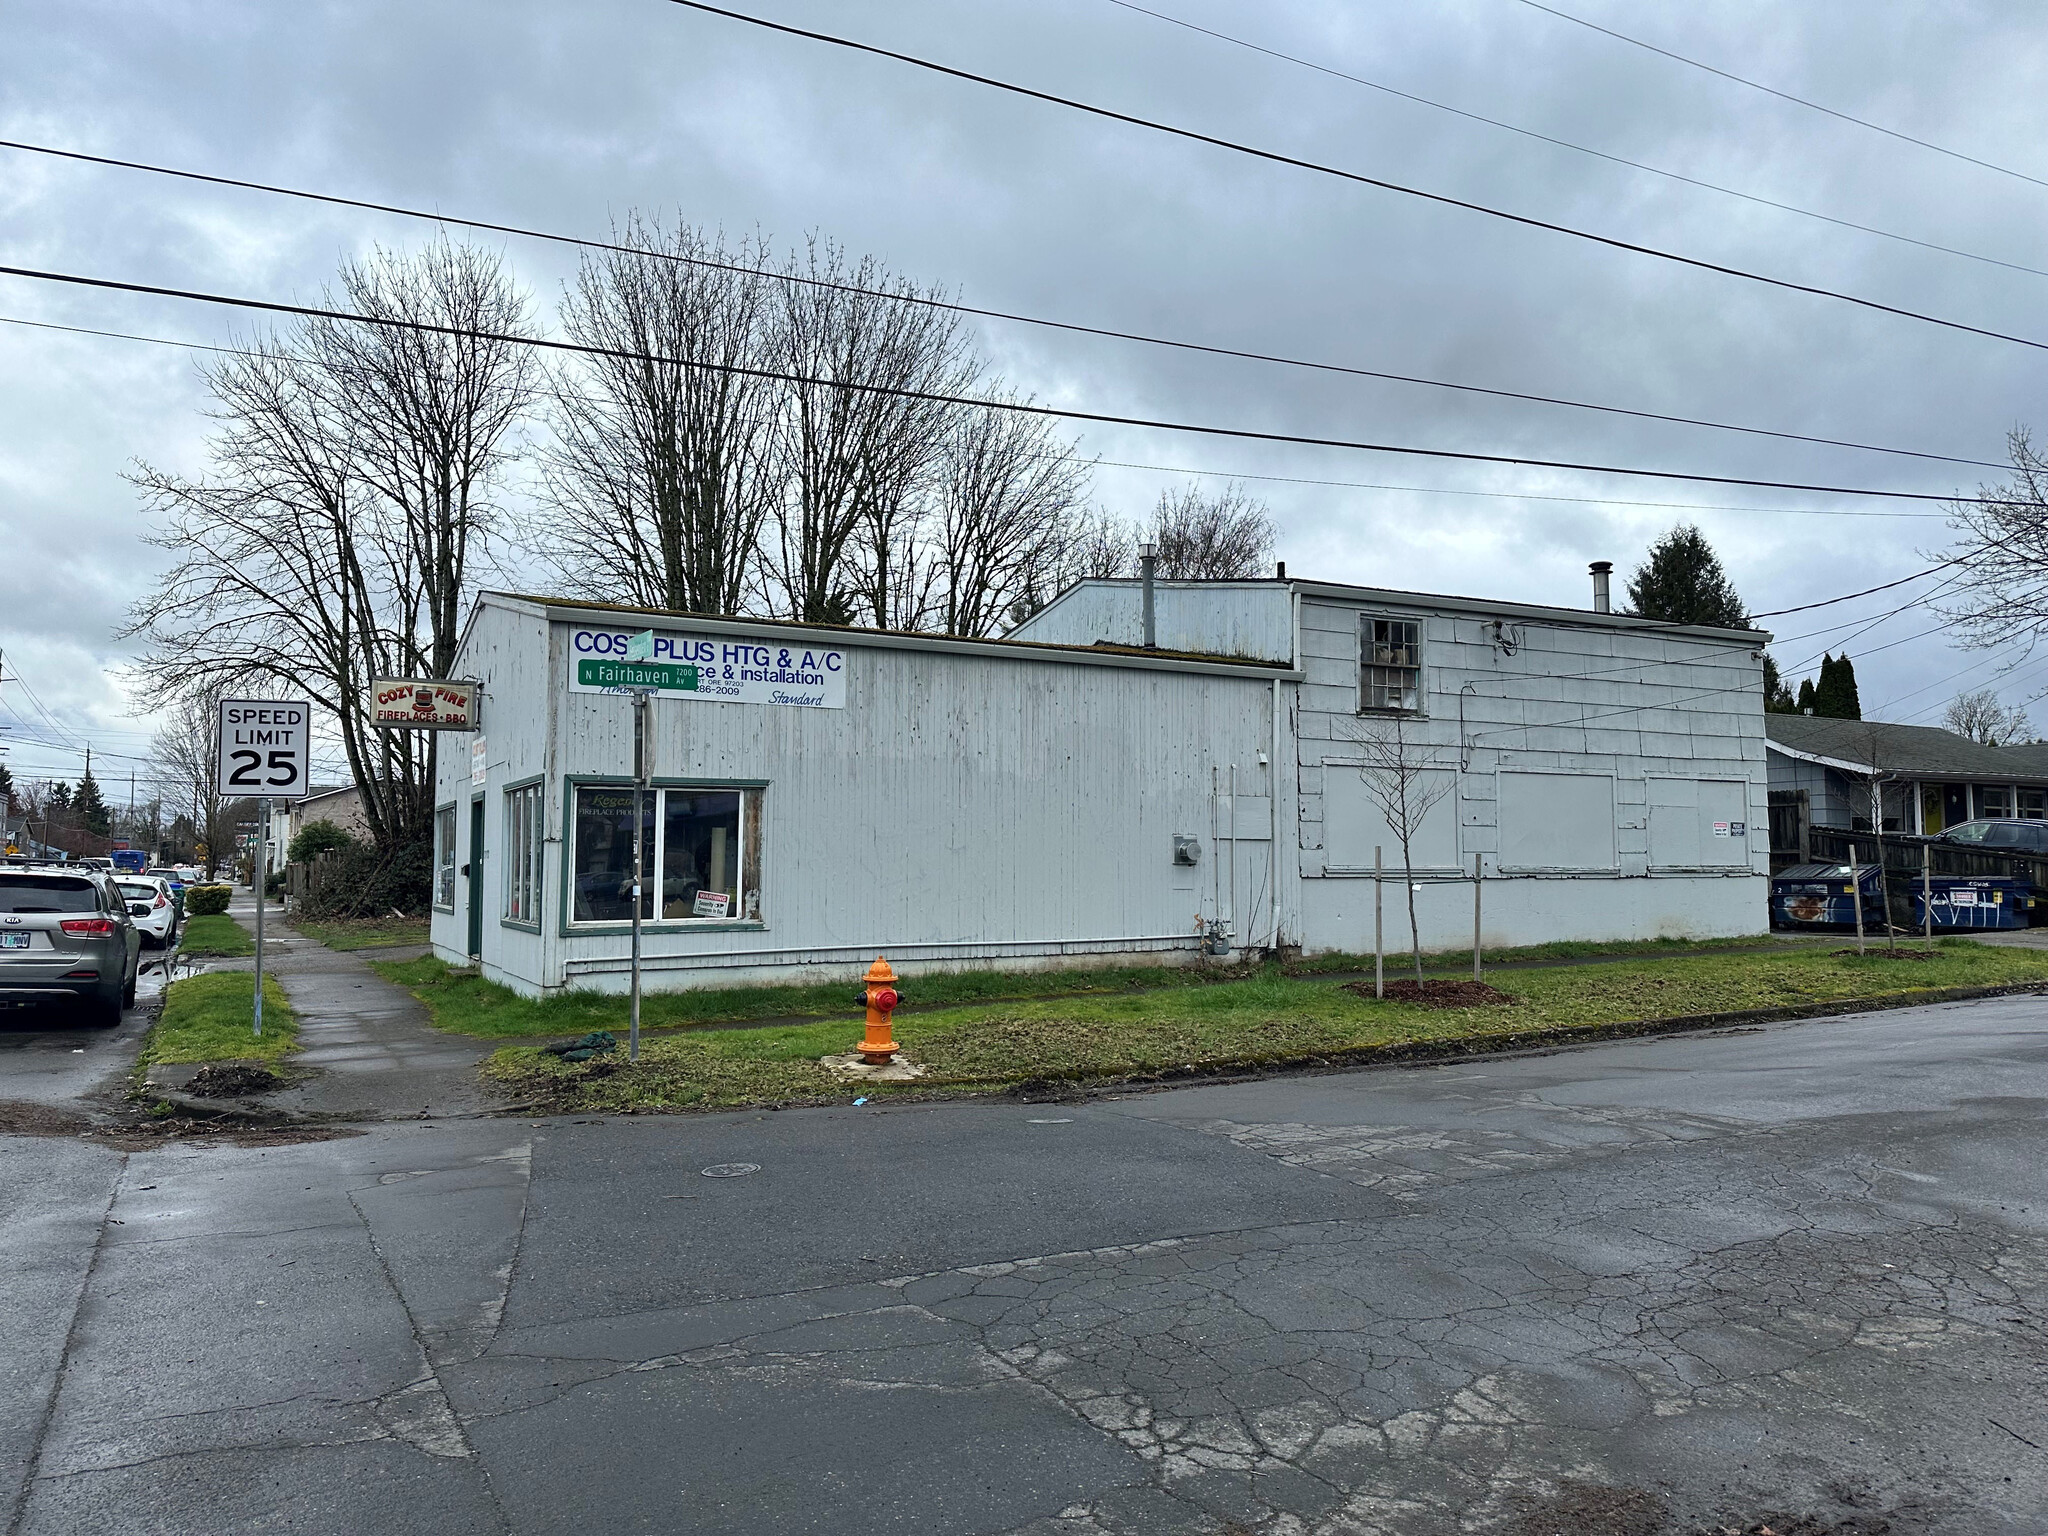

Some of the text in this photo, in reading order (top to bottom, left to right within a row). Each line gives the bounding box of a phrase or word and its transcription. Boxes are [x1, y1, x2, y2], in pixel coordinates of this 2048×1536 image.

[574, 631, 635, 656] COS
[653, 638, 715, 662] PLUS
[722, 644, 770, 667] HTG
[776, 648, 793, 669] &
[800, 650, 842, 672] A/C
[585, 665, 669, 684] N Fairhaven
[676, 668, 693, 677] 7200
[722, 664, 735, 680] &
[740, 665, 824, 686] installation
[707, 679, 722, 687] ORE
[377, 685, 468, 708] COZY FIRE
[767, 690, 825, 706] Standard
[227, 708, 302, 725] SPEED
[377, 710, 438, 723] FIREPLACES
[234, 729, 294, 745] LIMIT
[228, 749, 299, 787] 25
